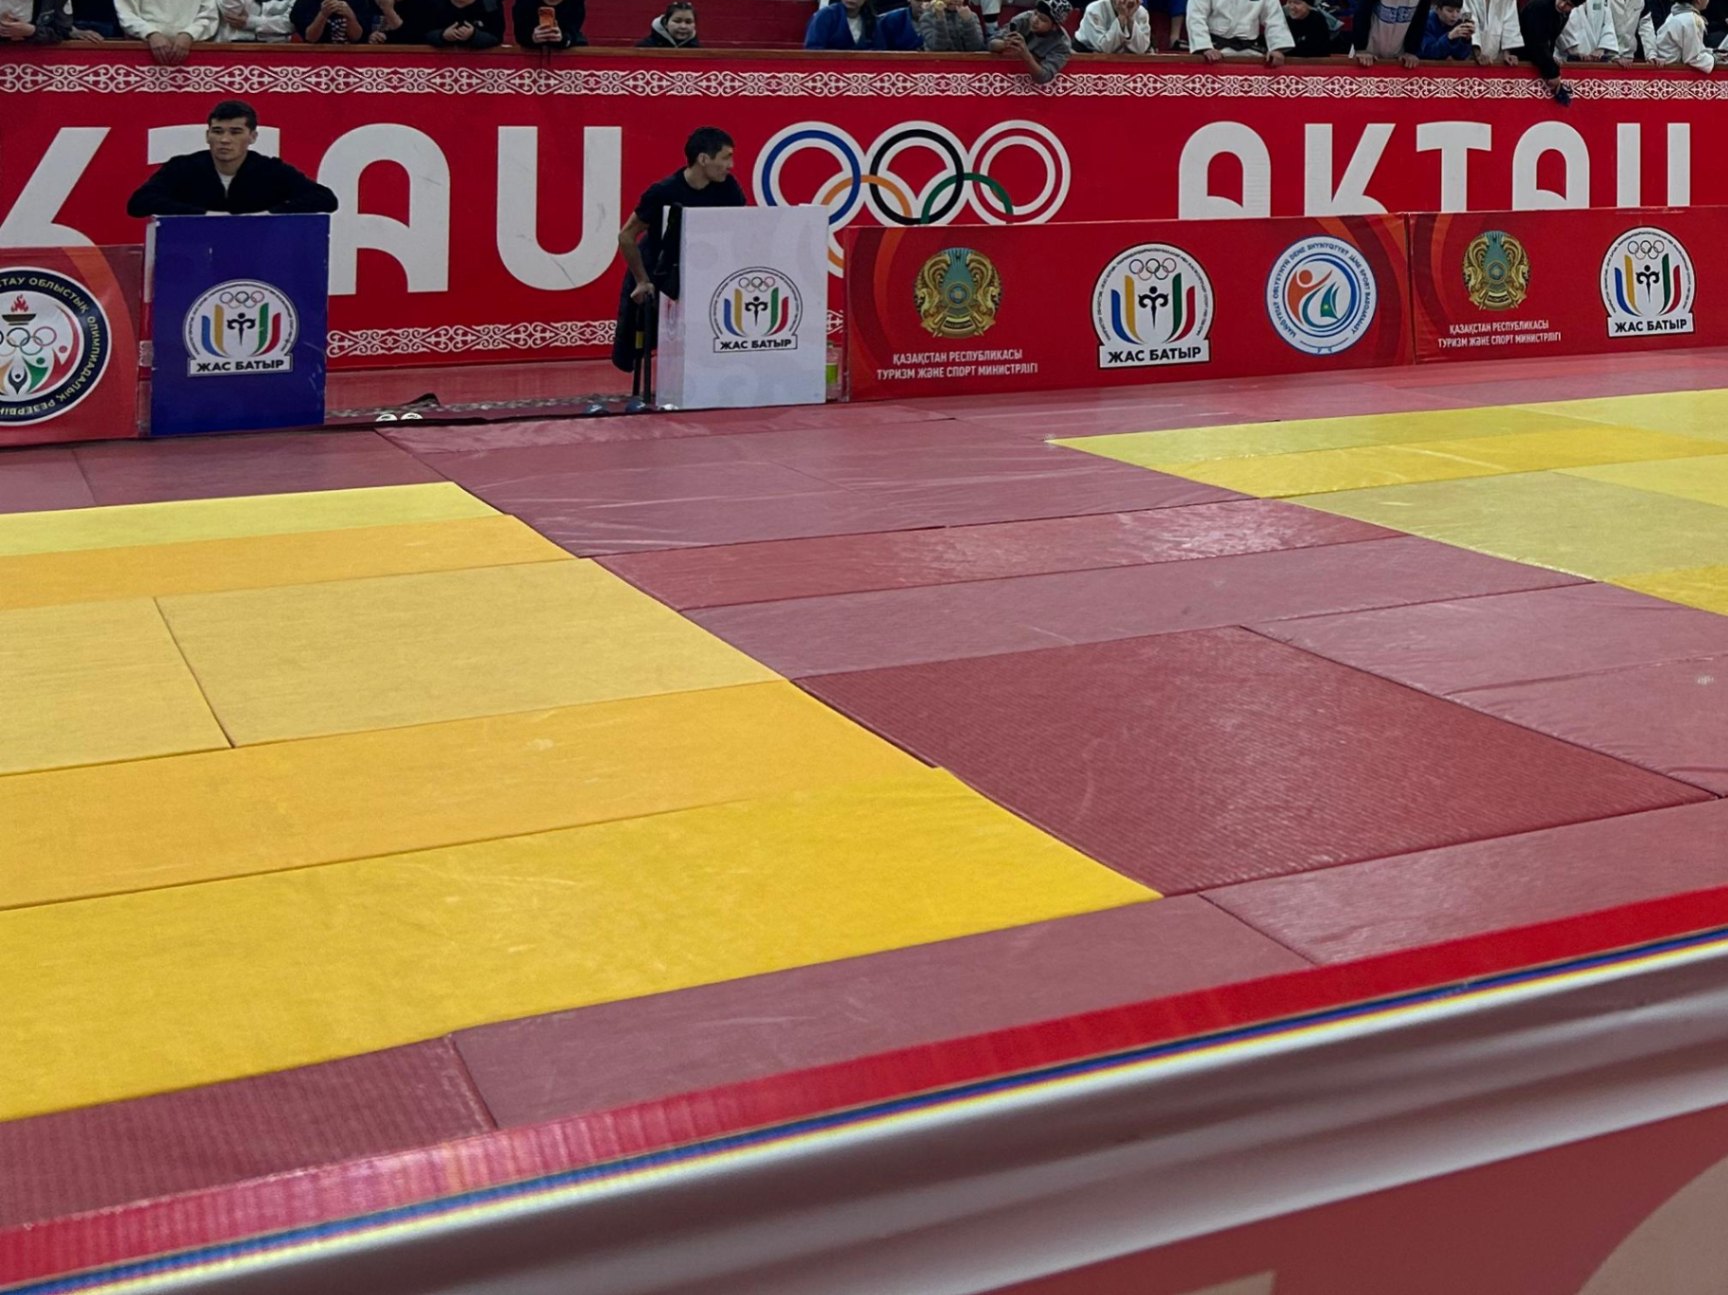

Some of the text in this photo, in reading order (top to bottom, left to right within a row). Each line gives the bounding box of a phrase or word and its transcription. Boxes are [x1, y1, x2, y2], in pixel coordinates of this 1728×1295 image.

[1614, 319, 1687, 333] ЖАС БАТЫР
[720, 338, 792, 350] ЖАС БАТЫР
[892, 349, 1023, 365] ҚАЗАҚСТАН РЕСПУБЛИКАСЫ
[1107, 346, 1202, 364] ЖАС БАТЫР
[196, 359, 285, 373] ЖАС БАТЫР
[876, 362, 1038, 381] ТУРИЗМ ЖӘНЕ СПОРТ МИНИСТРЛІГІ
